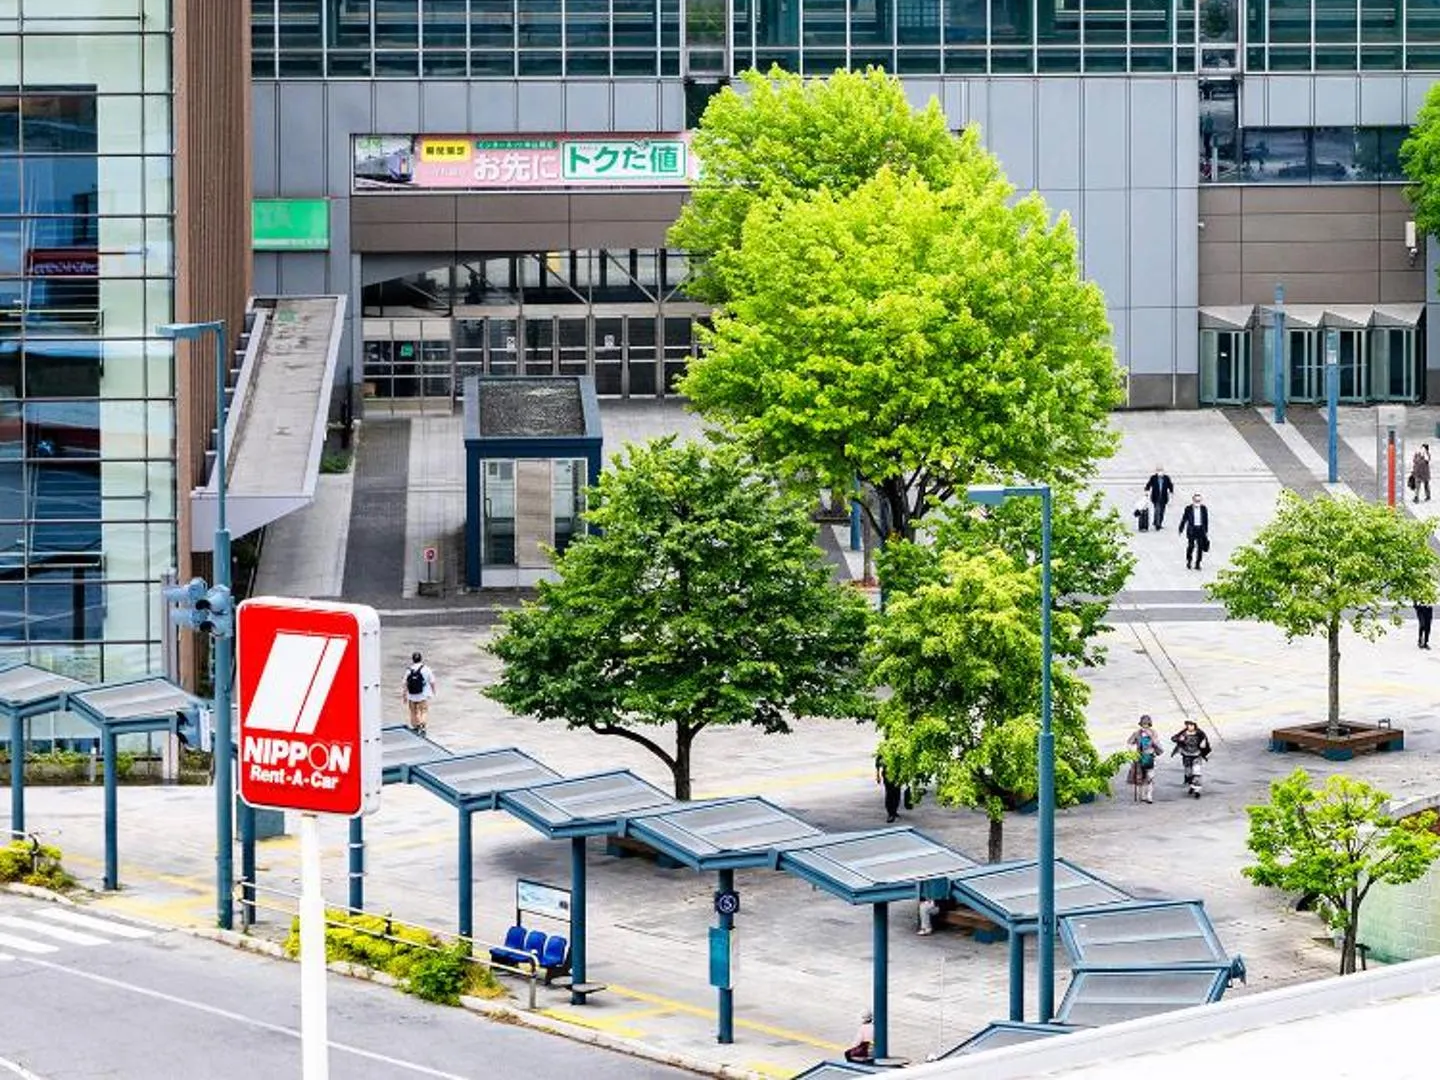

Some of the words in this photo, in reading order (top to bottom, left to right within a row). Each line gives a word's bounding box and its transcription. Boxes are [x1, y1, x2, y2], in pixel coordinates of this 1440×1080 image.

[474, 152, 558, 180] お先に
[243, 735, 352, 774] NIPPON
